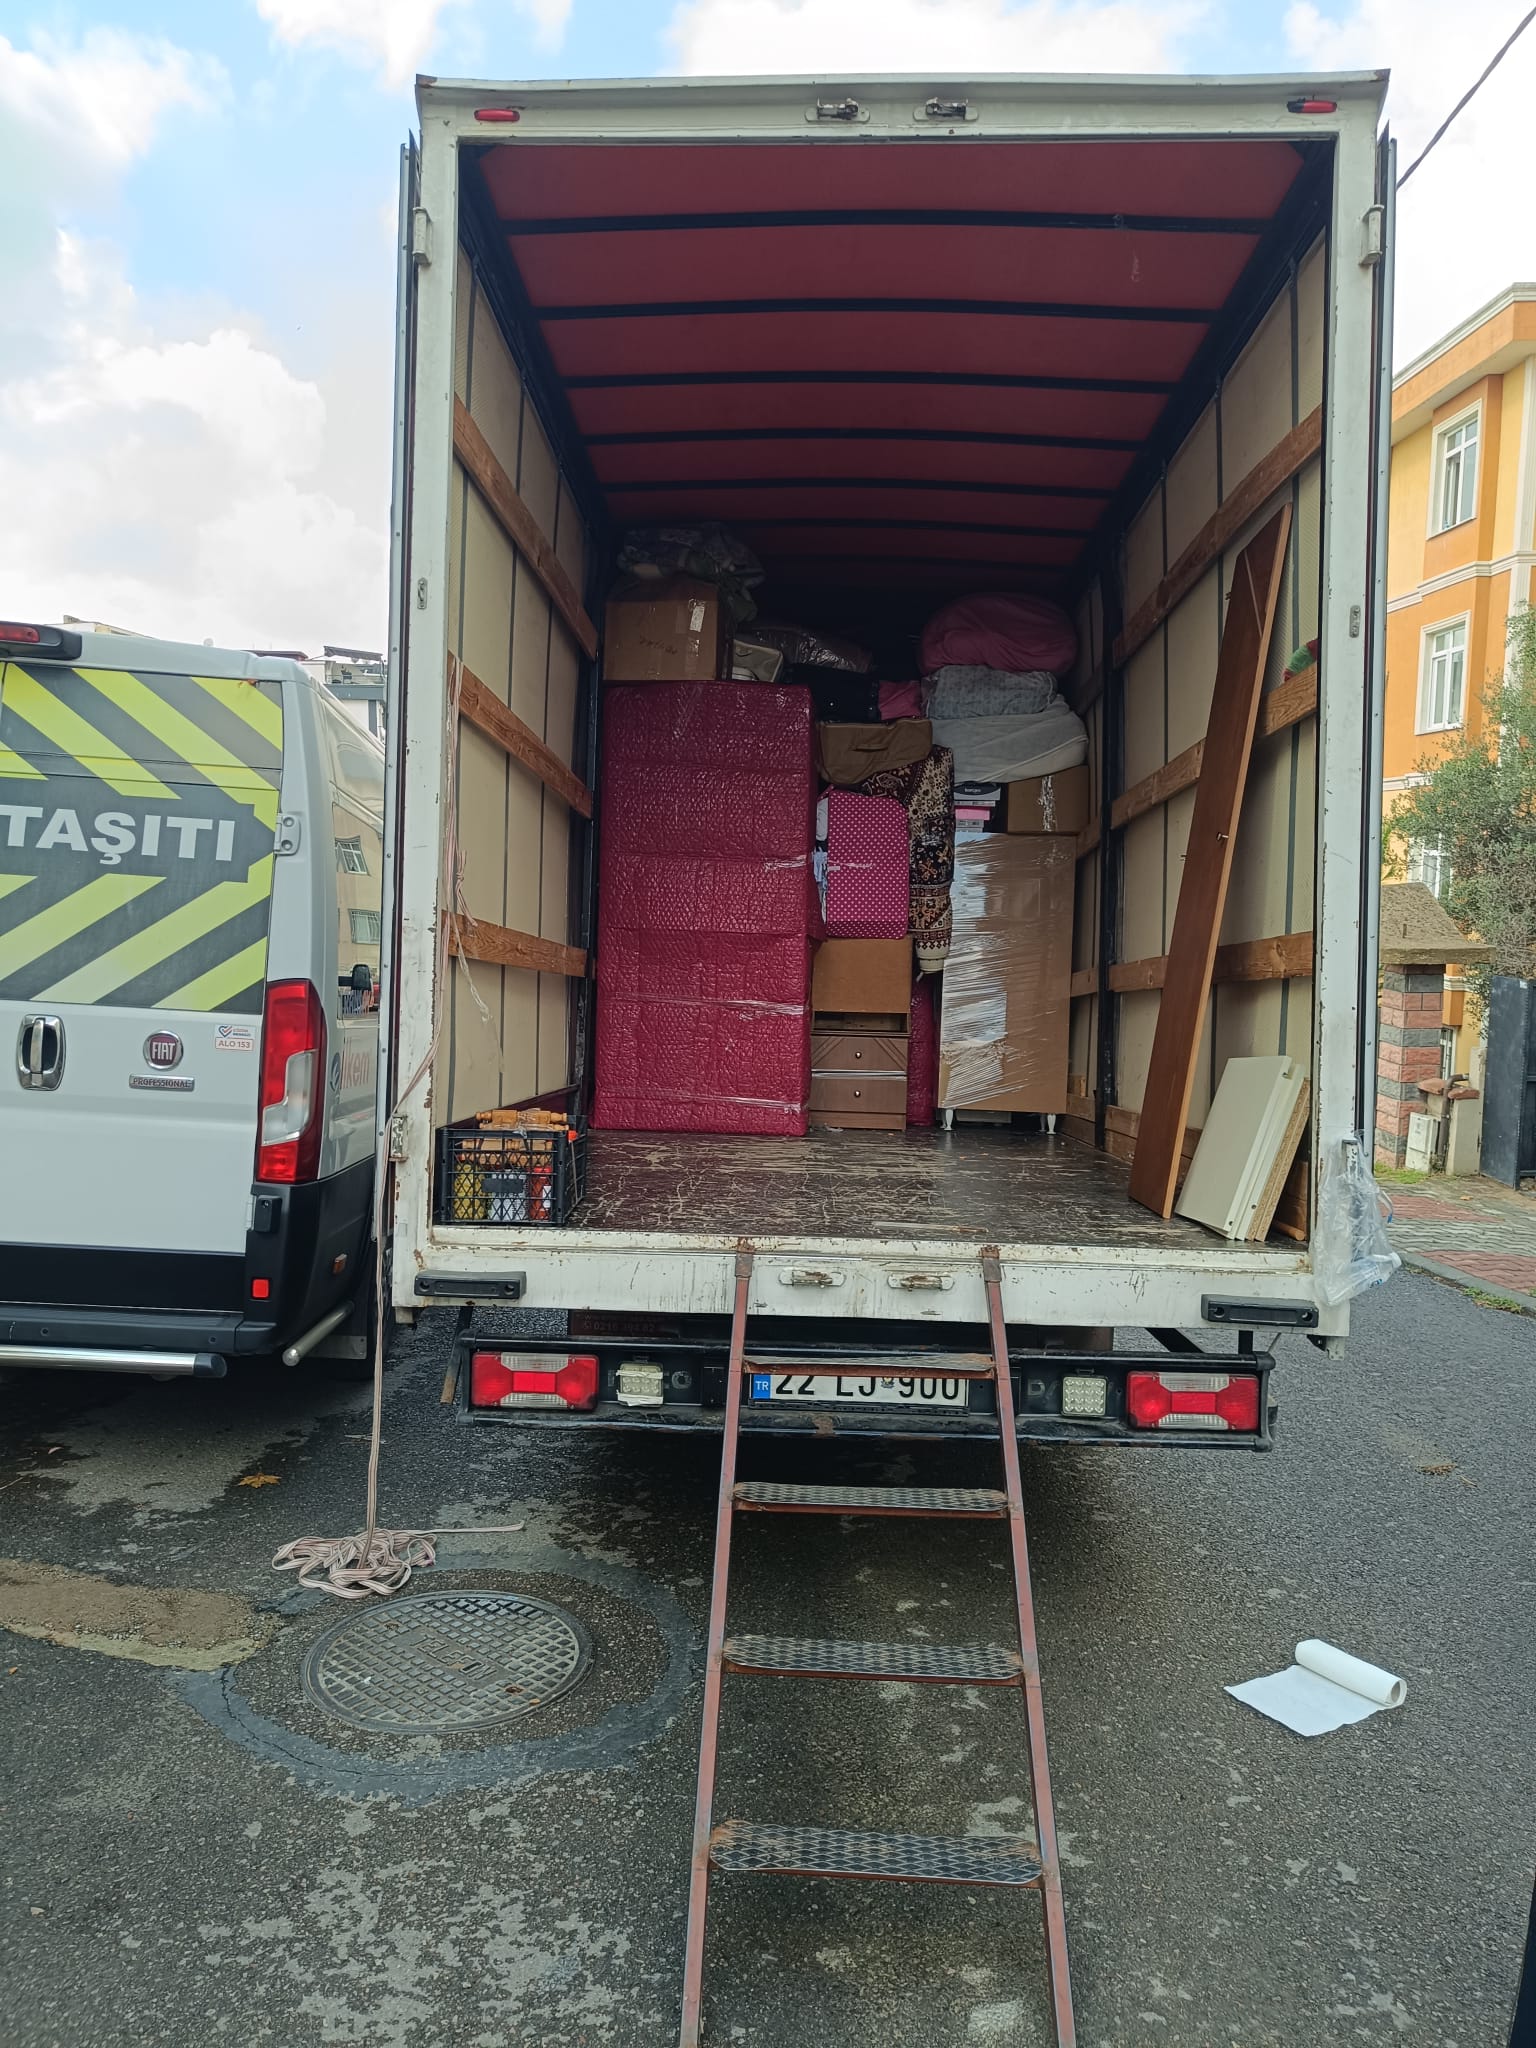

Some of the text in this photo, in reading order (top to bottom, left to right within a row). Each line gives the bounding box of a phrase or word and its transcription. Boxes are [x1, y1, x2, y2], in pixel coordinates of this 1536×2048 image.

[0, 804, 236, 866] TAŞITI
[152, 1041, 176, 1061] FIAT
[218, 1040, 250, 1049] ALO 153
[132, 1077, 192, 1088] PROFESSIONAL
[755, 1380, 769, 1391] TR
[775, 1374, 815, 1396] 22
[409, 1634, 498, 1681] TELEFON
